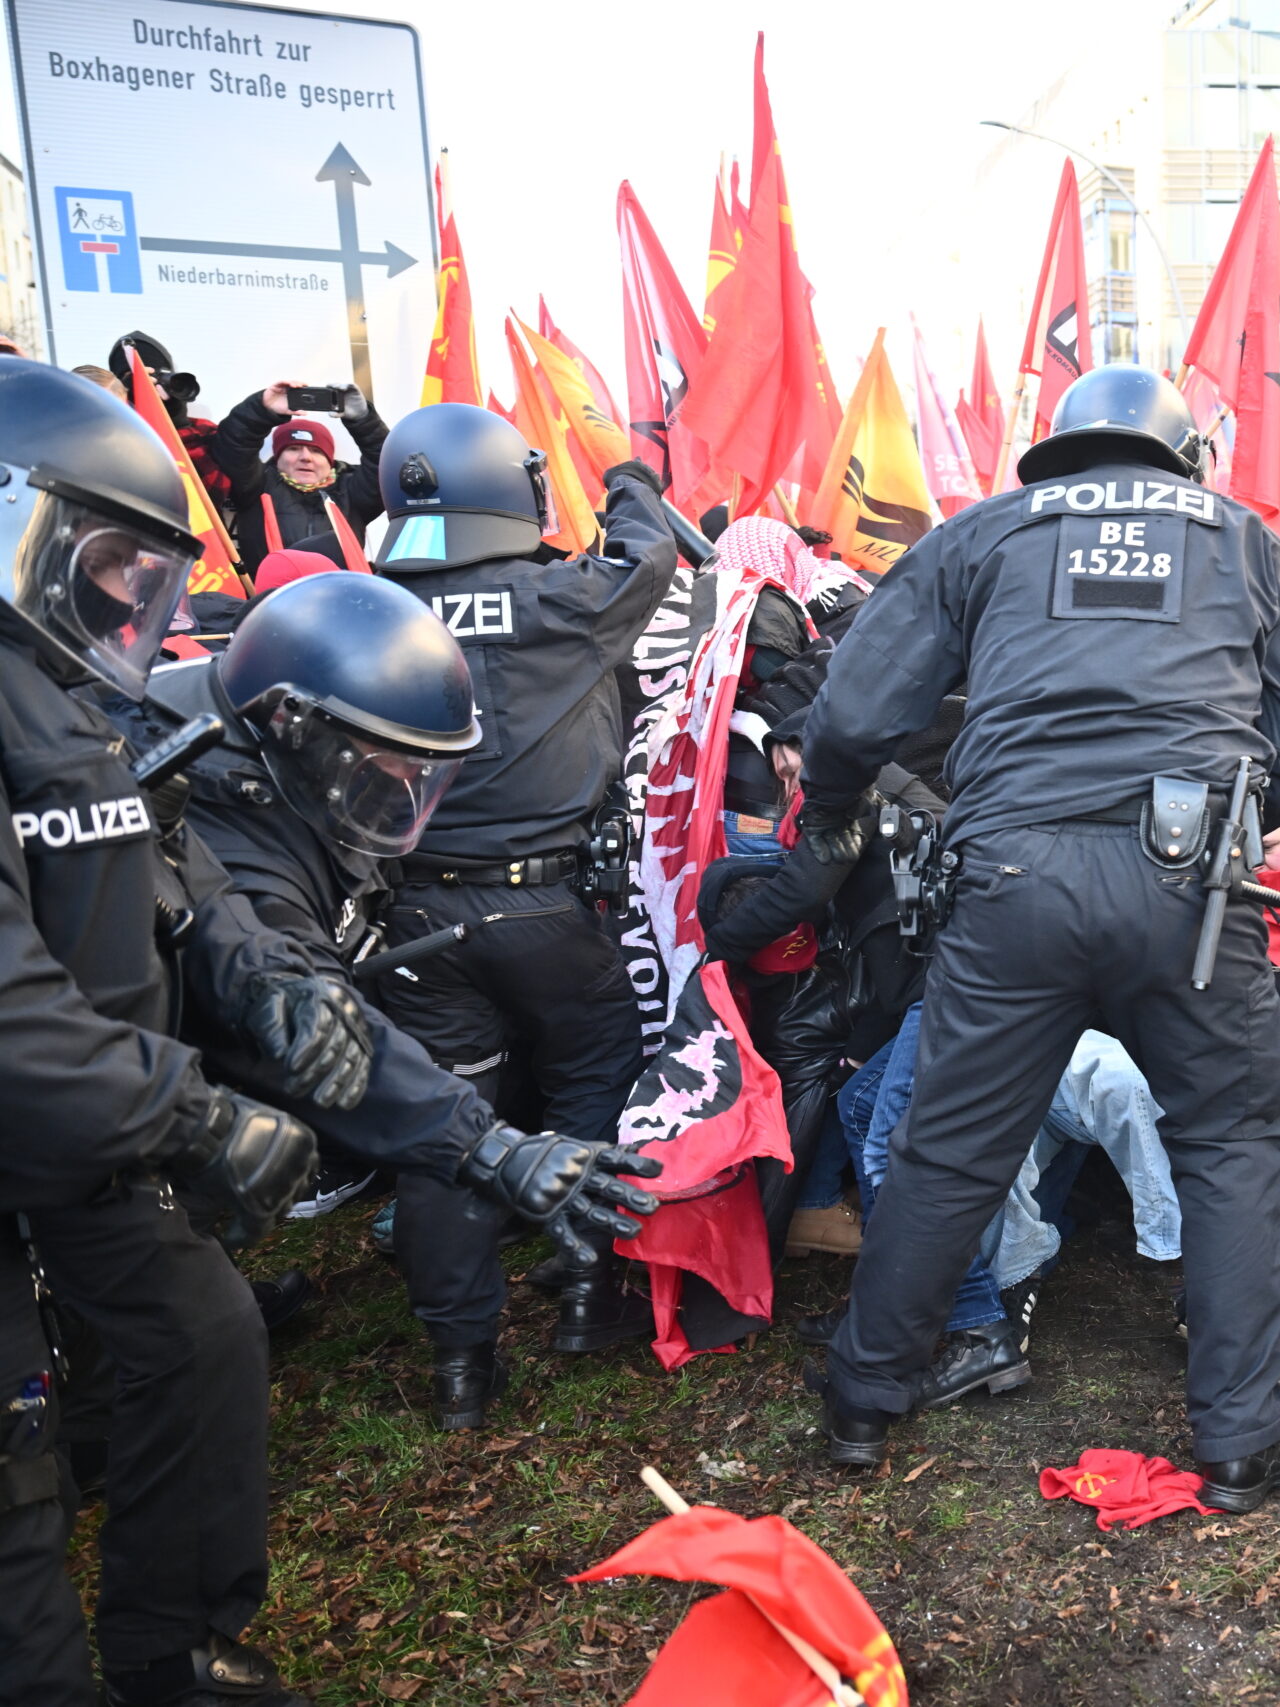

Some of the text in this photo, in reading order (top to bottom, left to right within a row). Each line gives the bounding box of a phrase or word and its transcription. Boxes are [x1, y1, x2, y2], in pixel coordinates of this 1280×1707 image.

[132, 19, 312, 62] Durchfahrt zur
[49, 51, 396, 111] Boxhagener Straße gesperrt
[157, 264, 329, 292] Niederbarnimstraße
[1030, 481, 1215, 520] POLIZEI
[1099, 521, 1146, 547] BE
[1067, 549, 1172, 578] 15228
[12, 796, 151, 849] POLIZEI
